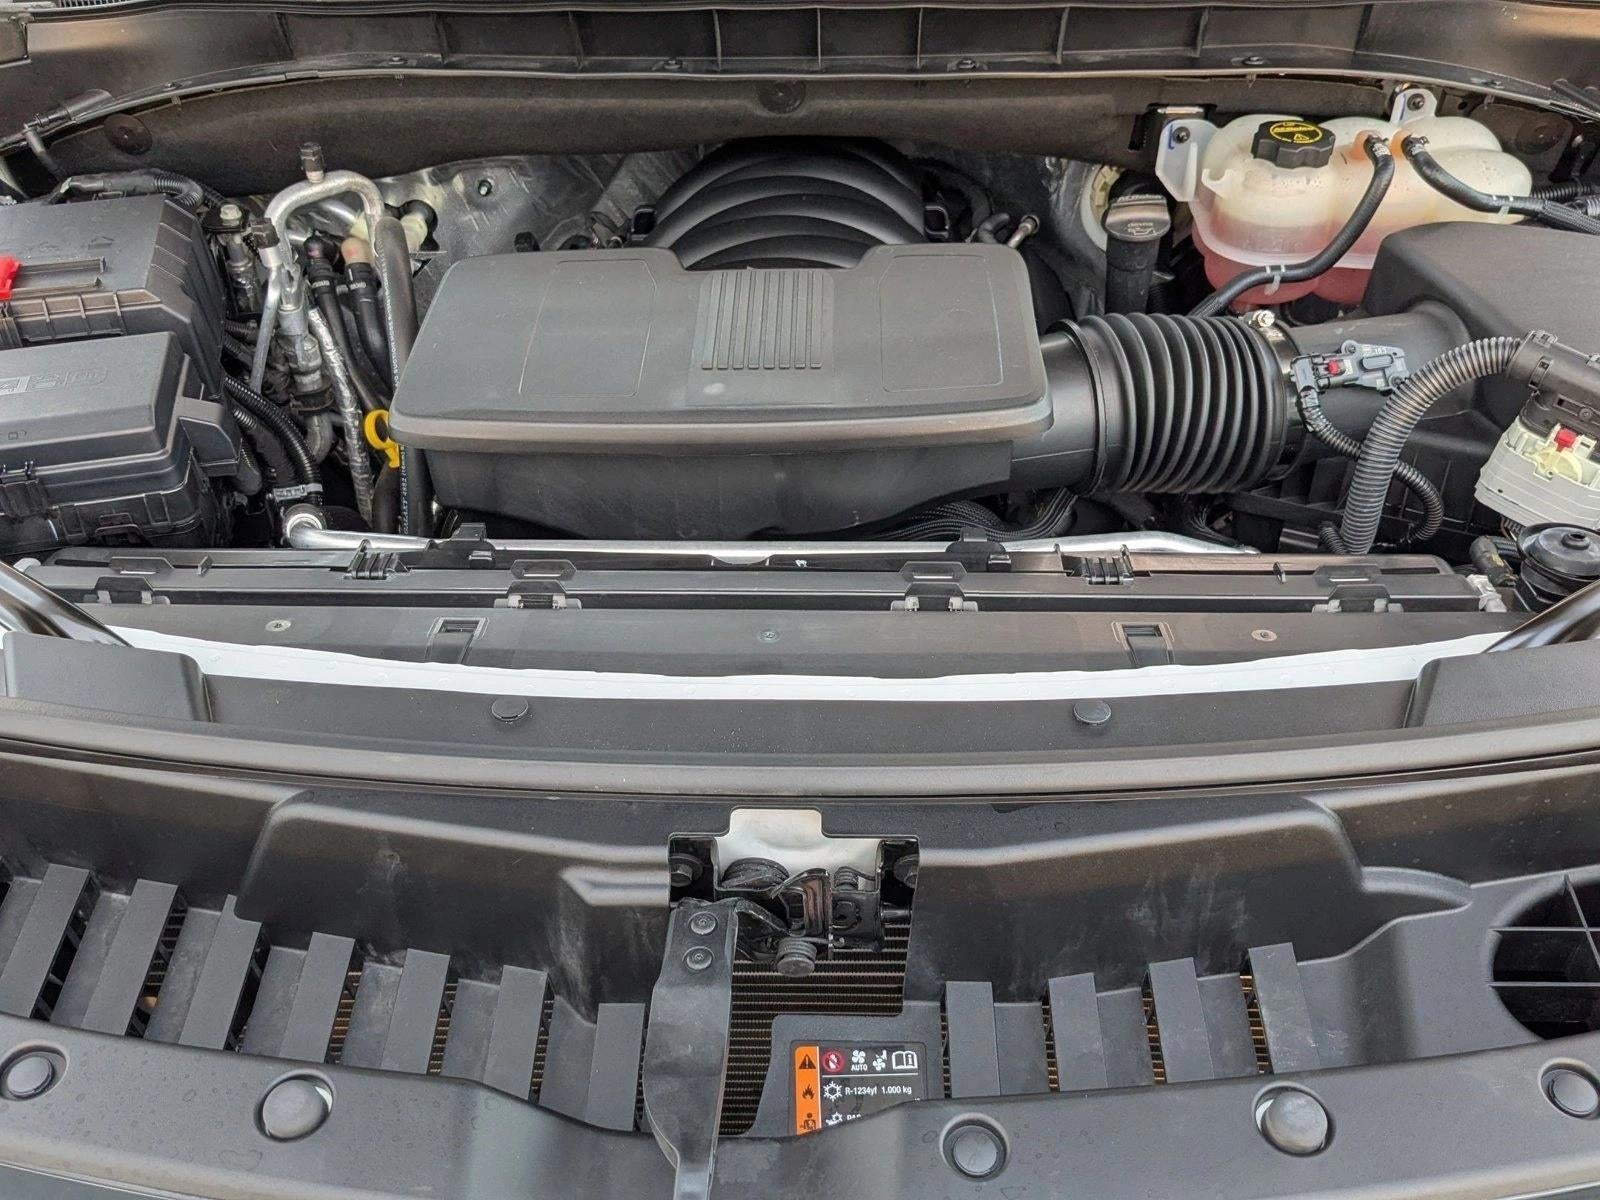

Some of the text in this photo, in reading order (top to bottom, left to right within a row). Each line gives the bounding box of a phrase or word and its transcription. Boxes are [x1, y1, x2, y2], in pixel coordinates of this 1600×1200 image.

[845, 1085, 912, 1096] R-1234yf 1.000 kg
